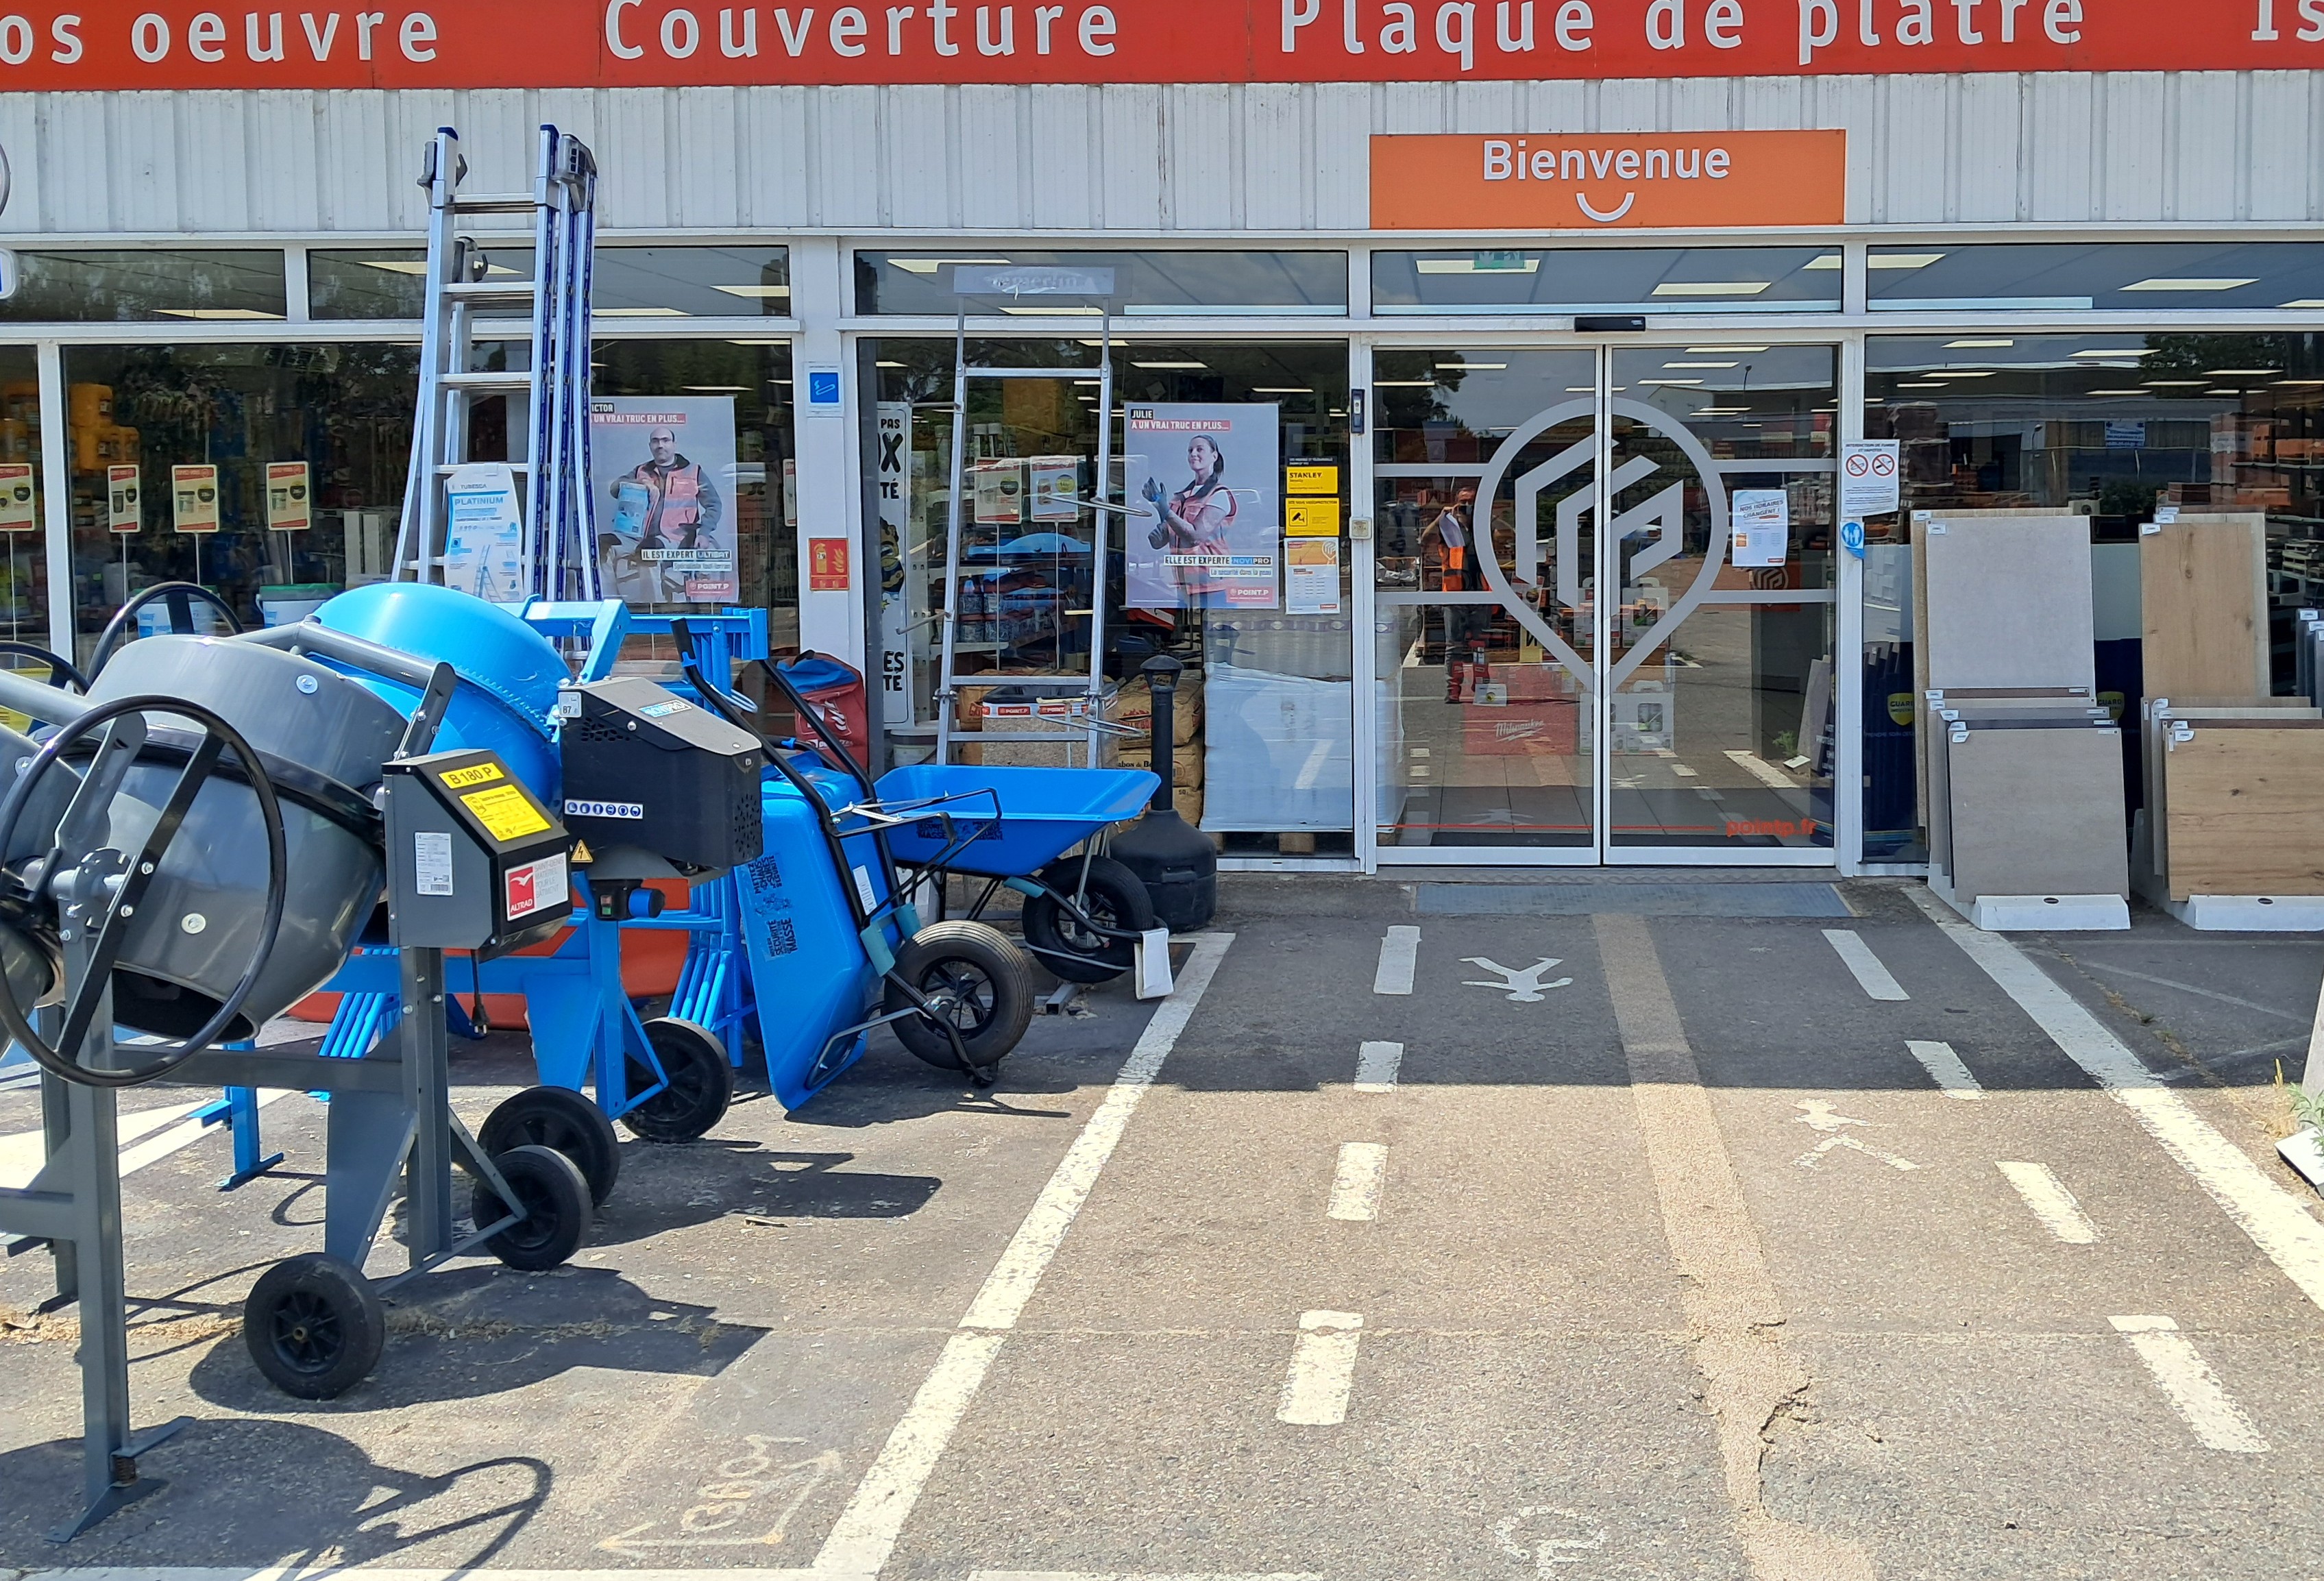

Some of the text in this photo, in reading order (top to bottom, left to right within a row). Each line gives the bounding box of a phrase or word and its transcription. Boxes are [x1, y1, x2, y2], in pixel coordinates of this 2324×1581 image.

[131, 12, 439, 63] oeuvre
[604, 0, 1118, 60] Couverture
[1280, 0, 1594, 71] Plaque
[1645, 0, 1744, 51] de
[1482, 139, 1731, 182] Bienvenue
[591, 404, 613, 413] ICTOR
[1132, 410, 1153, 419] JULIE
[594, 415, 604, 423] UN
[606, 415, 624, 423] VRAI
[626, 415, 646, 423] TRUC
[647, 415, 657, 423] EN
[881, 418, 901, 429] PAS
[1132, 421, 1137, 430] A
[1138, 421, 1149, 430] UN
[1151, 421, 1169, 430] VRAI
[1171, 421, 1190, 430] TRUC
[1192, 421, 1201, 430] EN
[878, 432, 903, 473] X
[880, 478, 900, 500] TÉ
[1739, 499, 1784, 513] NOS HORAIRES
[1743, 508, 1776, 519] CHANGENT
[643, 551, 650, 559] IL
[667, 550, 694, 559] EXPERT
[1165, 556, 1182, 565] ELLE
[1184, 556, 1197, 565] EST
[883, 651, 905, 672] ES
[448, 766, 493, 785] B 180 P
[1726, 818, 1818, 838] pointp.fr
[535, 857, 564, 872] SAINT-DENIS
[510, 898, 533, 914] ALTRAD
[781, 917, 798, 953] MASSE
